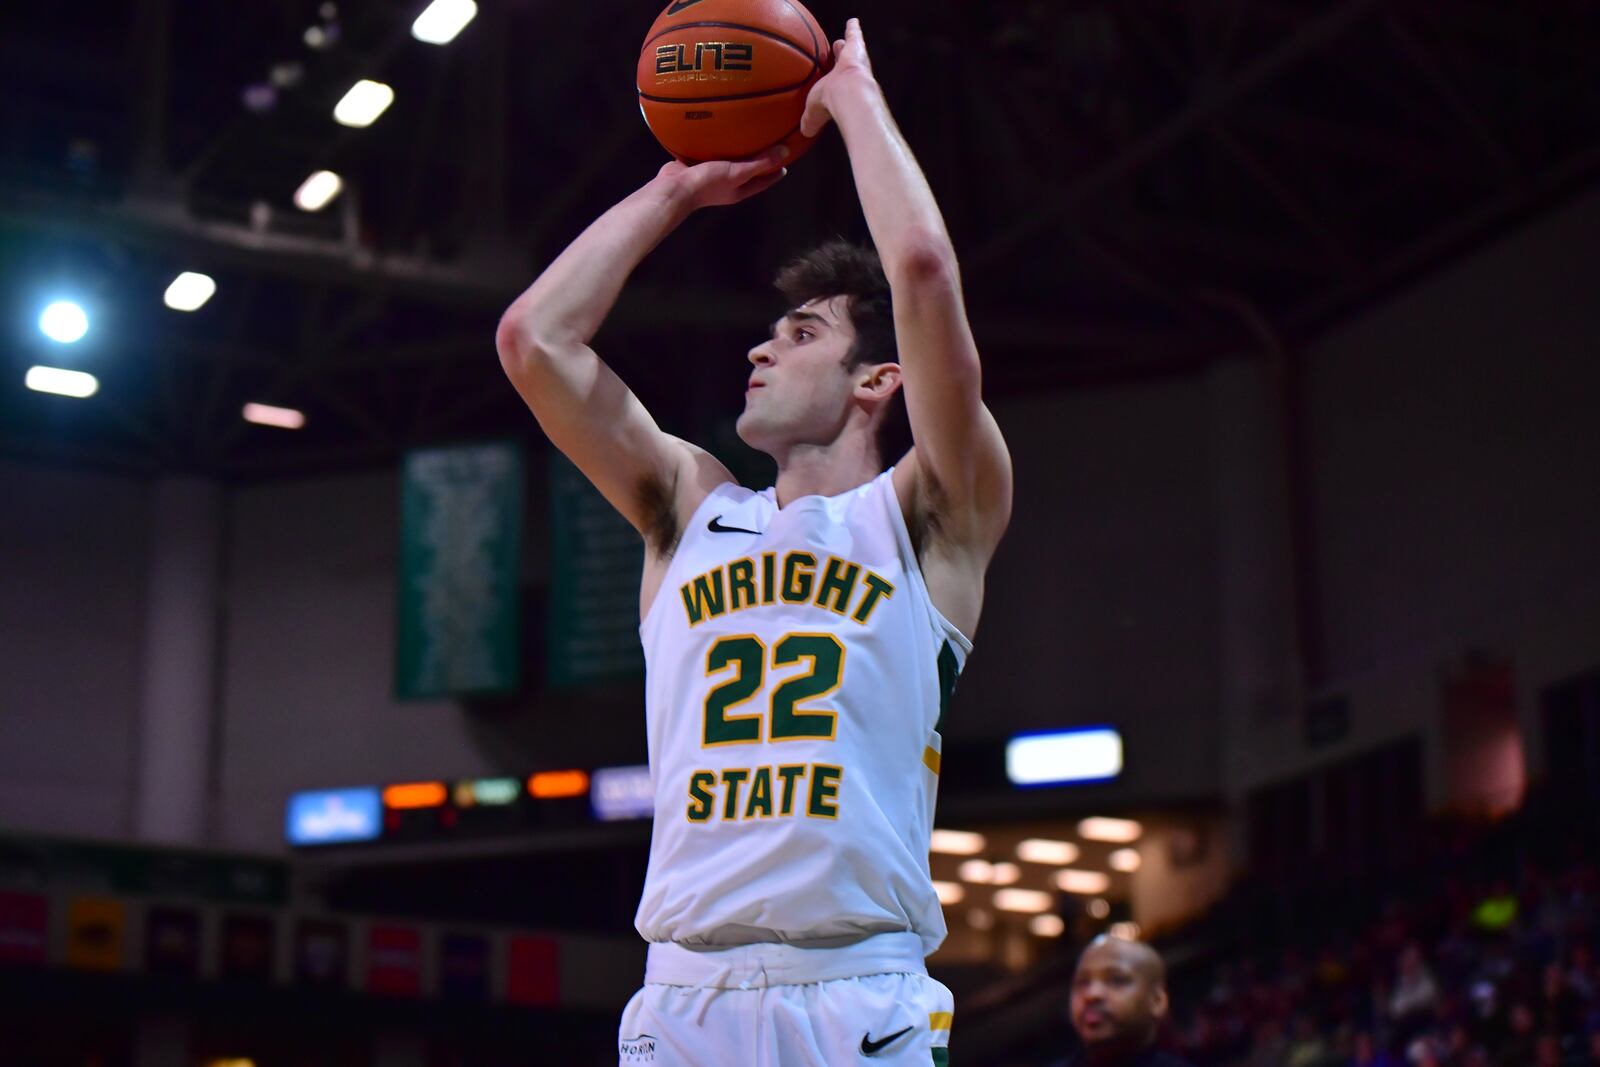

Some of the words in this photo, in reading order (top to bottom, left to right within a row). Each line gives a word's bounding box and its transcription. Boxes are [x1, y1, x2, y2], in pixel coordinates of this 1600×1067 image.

[656, 41, 752, 74] ELITE
[679, 550, 896, 628] WRIGHT
[701, 632, 846, 749] 22
[687, 763, 843, 823] STATE
